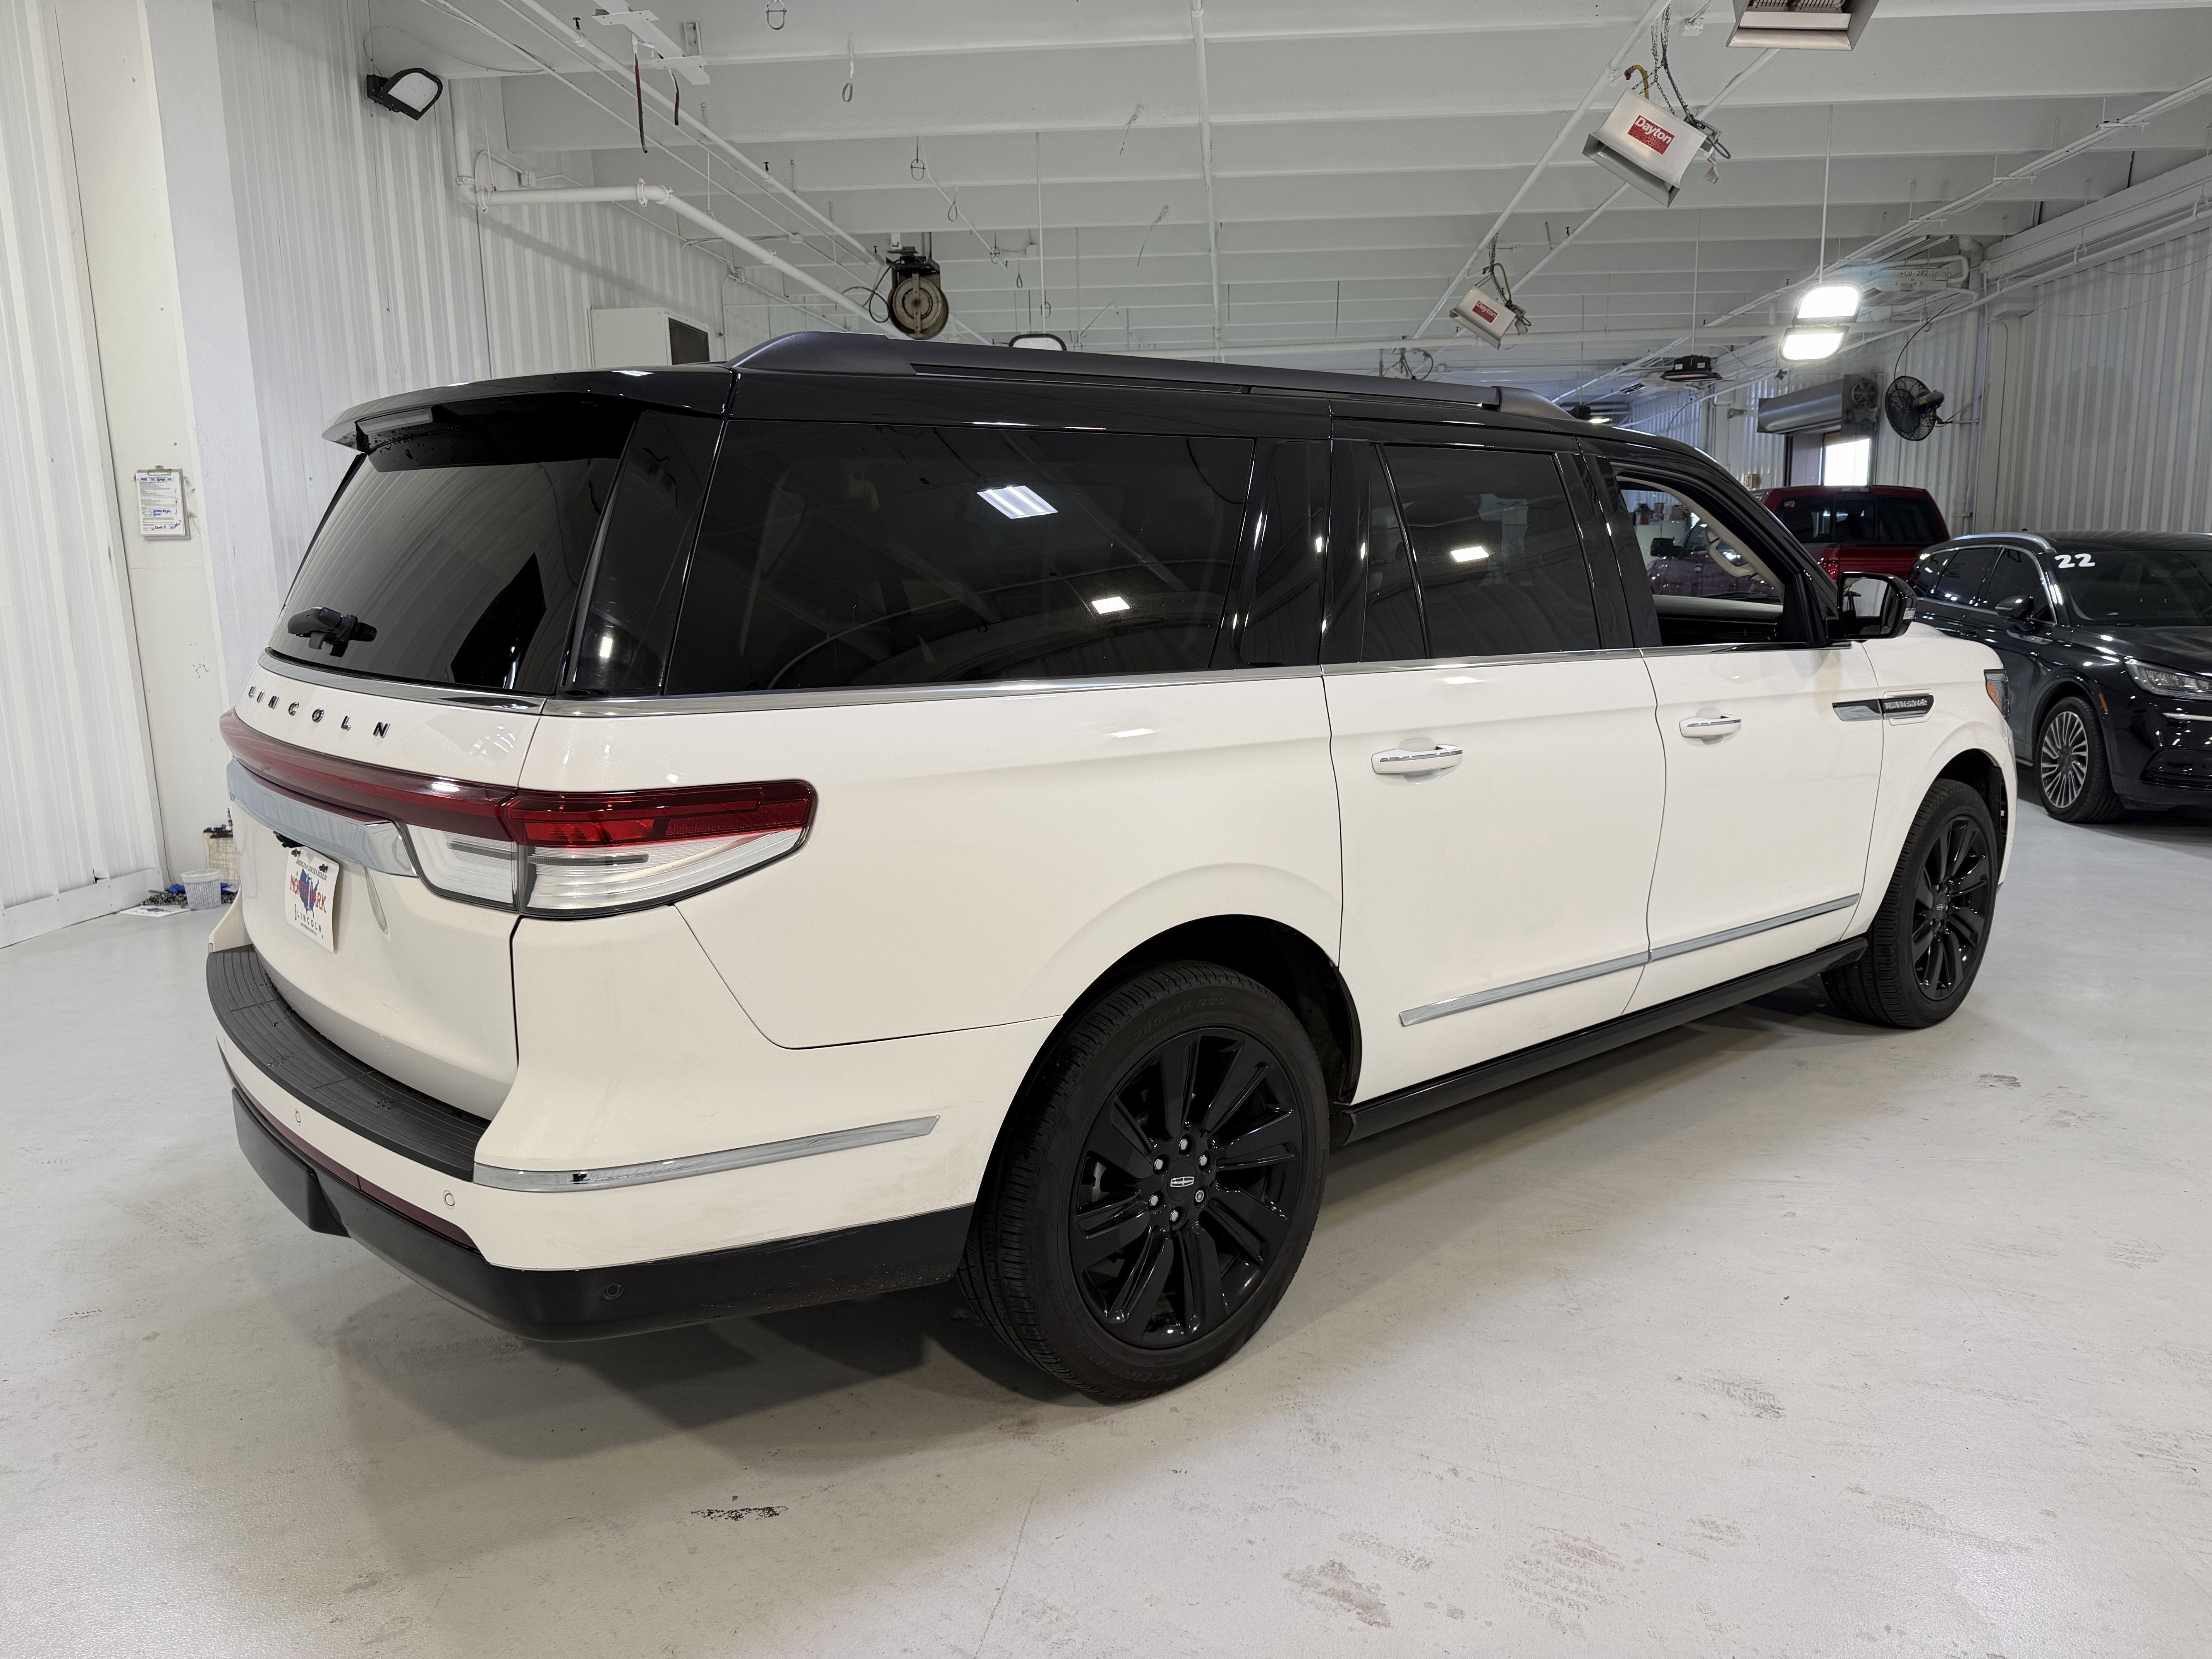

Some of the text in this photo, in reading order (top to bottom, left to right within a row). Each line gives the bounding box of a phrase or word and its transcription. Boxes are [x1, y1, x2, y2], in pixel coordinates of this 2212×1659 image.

[1635, 117, 1672, 144] Dayton
[1476, 302, 1497, 318] Dayton
[2054, 553, 2096, 568] 22
[248, 685, 391, 738] LINCOLN
[297, 910, 322, 933] LINCOLN
[1197, 998, 1228, 1008] R22
[1076, 1343, 1182, 1382] SCORION
